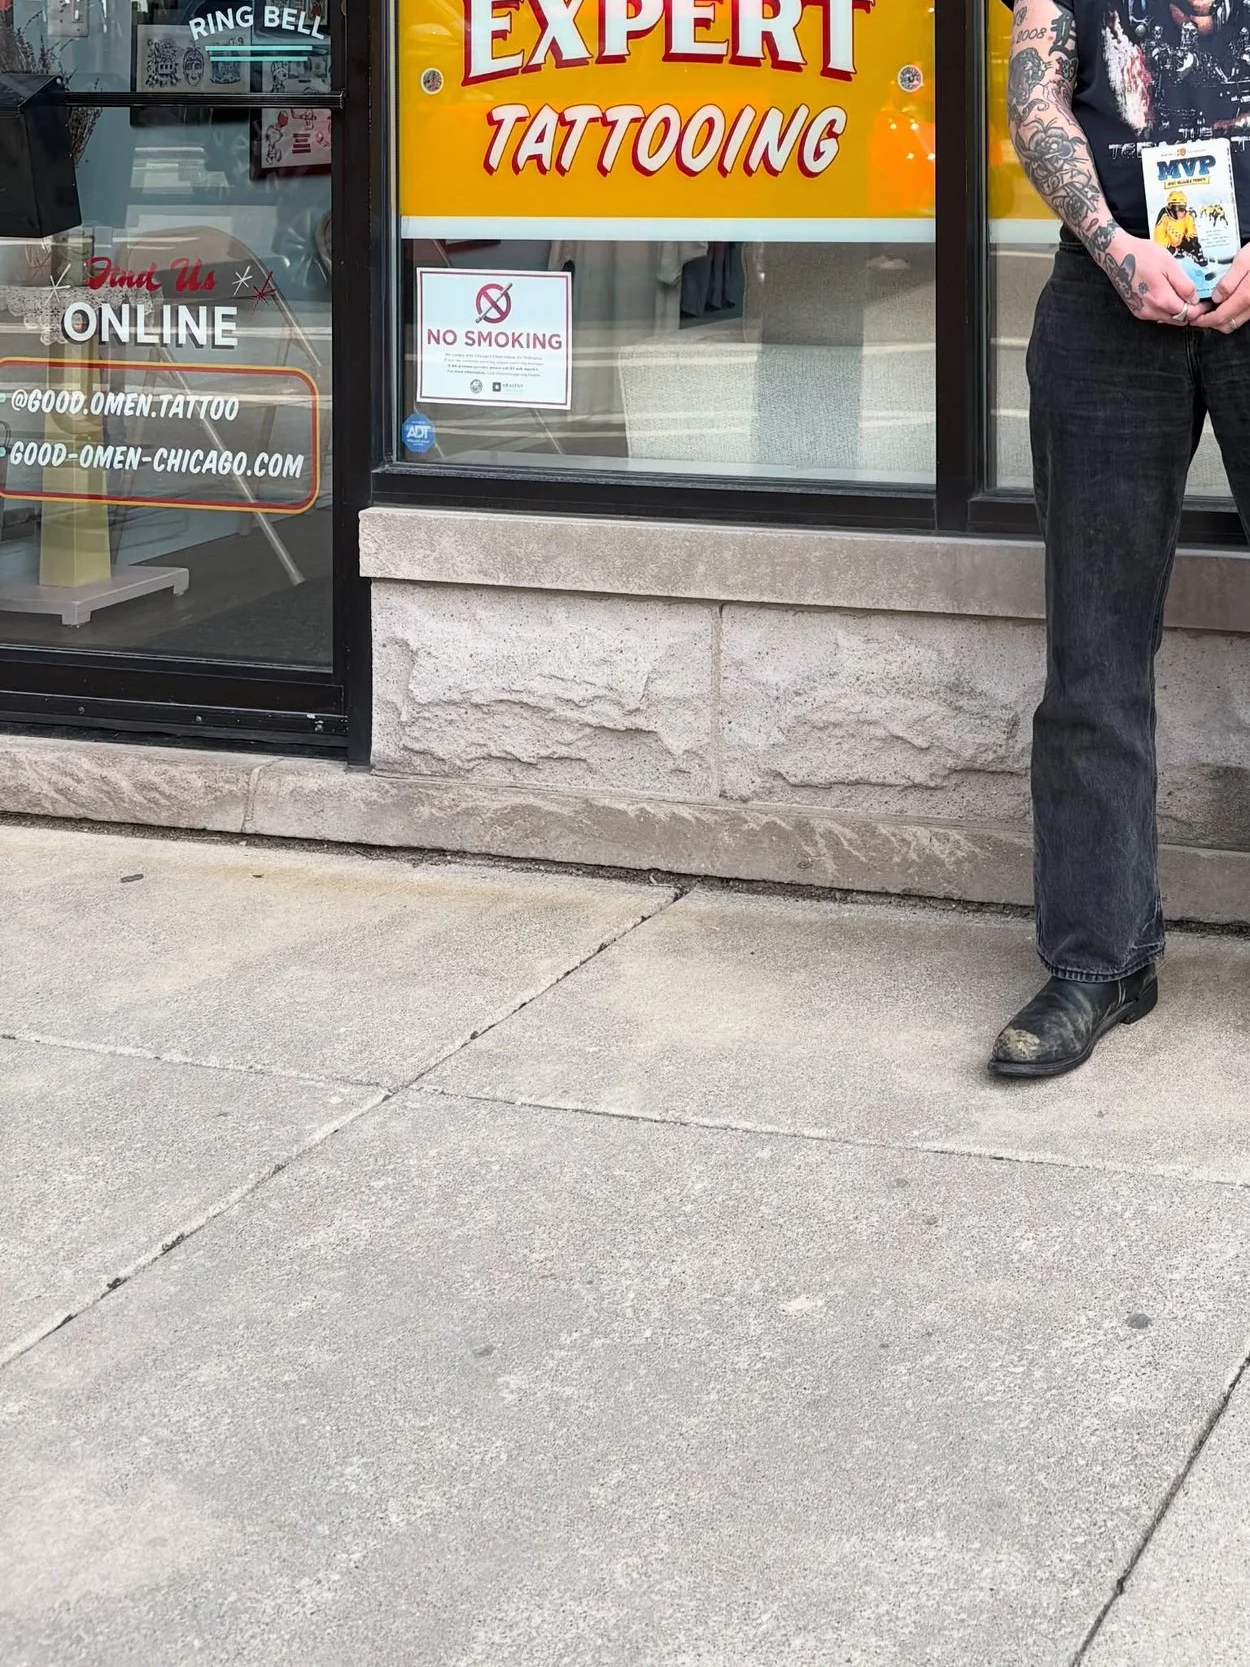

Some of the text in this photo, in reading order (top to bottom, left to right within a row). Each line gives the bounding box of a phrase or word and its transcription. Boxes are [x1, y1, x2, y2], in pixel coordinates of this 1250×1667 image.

[188, 5, 326, 41] RING BELL
[484, 103, 847, 178] TATTOOING
[1157, 155, 1216, 181] MVP
[85, 256, 217, 292] Find Us
[61, 301, 238, 348] ONLINE
[427, 328, 562, 350] NO SMOKING
[11, 386, 239, 422] @GOOD.OMEN.TATTOO
[406, 425, 431, 439] ADT
[9, 438, 304, 479] GOOD-OMEN-CHICAGO.COM
